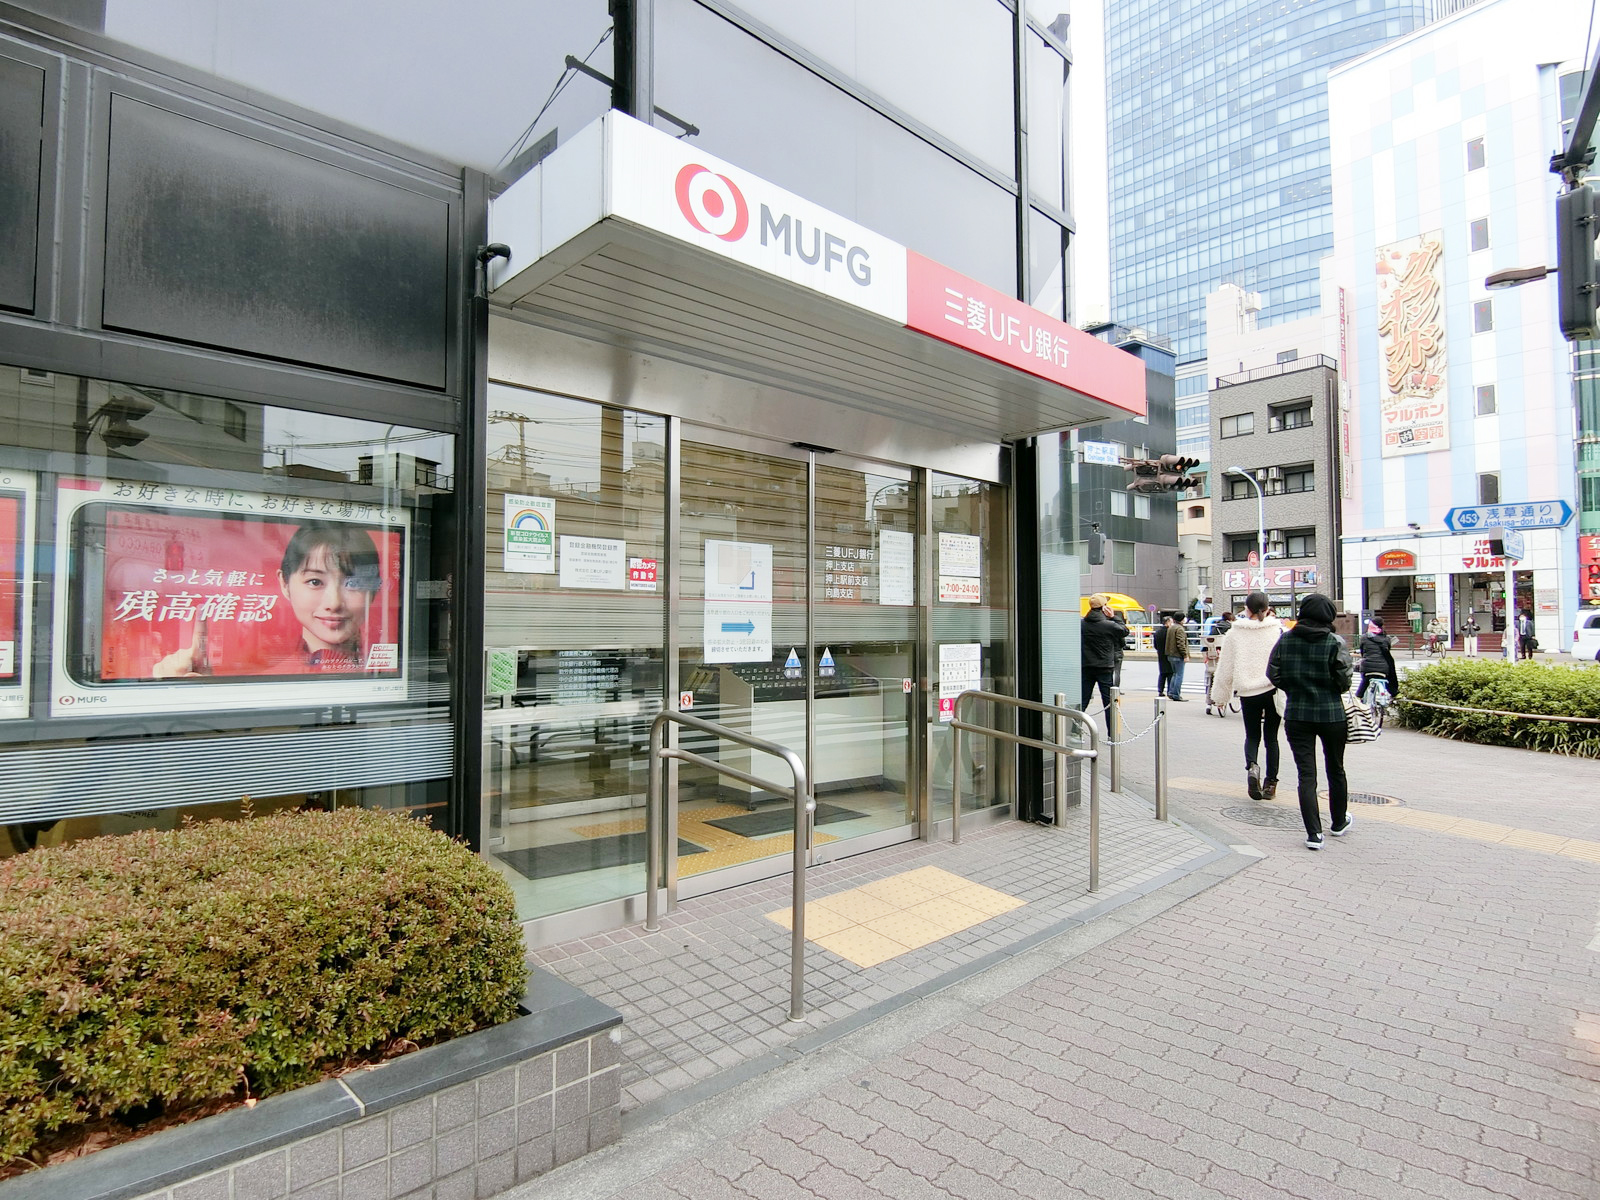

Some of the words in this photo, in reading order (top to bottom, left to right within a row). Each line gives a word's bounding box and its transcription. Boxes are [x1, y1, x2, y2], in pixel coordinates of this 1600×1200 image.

[760, 203, 872, 287] MUFG
[944, 287, 1070, 369] 三菱UFJ銀行
[1384, 404, 1444, 424] マルホン
[113, 481, 398, 522] お好きな時に、お好きな場所で。
[1460, 513, 1478, 524] 453
[1486, 504, 1552, 519] 浅草通り
[1483, 519, 1535, 528] Asakusa-dori
[1539, 516, 1556, 525] Ave.
[825, 546, 874, 560] 三菱UFJ銀行
[825, 560, 855, 572] 押上支店
[152, 568, 265, 587] さっと気軽に
[825, 573, 869, 587] 押上駅前支店
[825, 588, 854, 599] 向島支店
[946, 584, 979, 594] 7:00-24:00
[113, 590, 278, 623] 残高確認
[77, 695, 107, 703] MUFG
